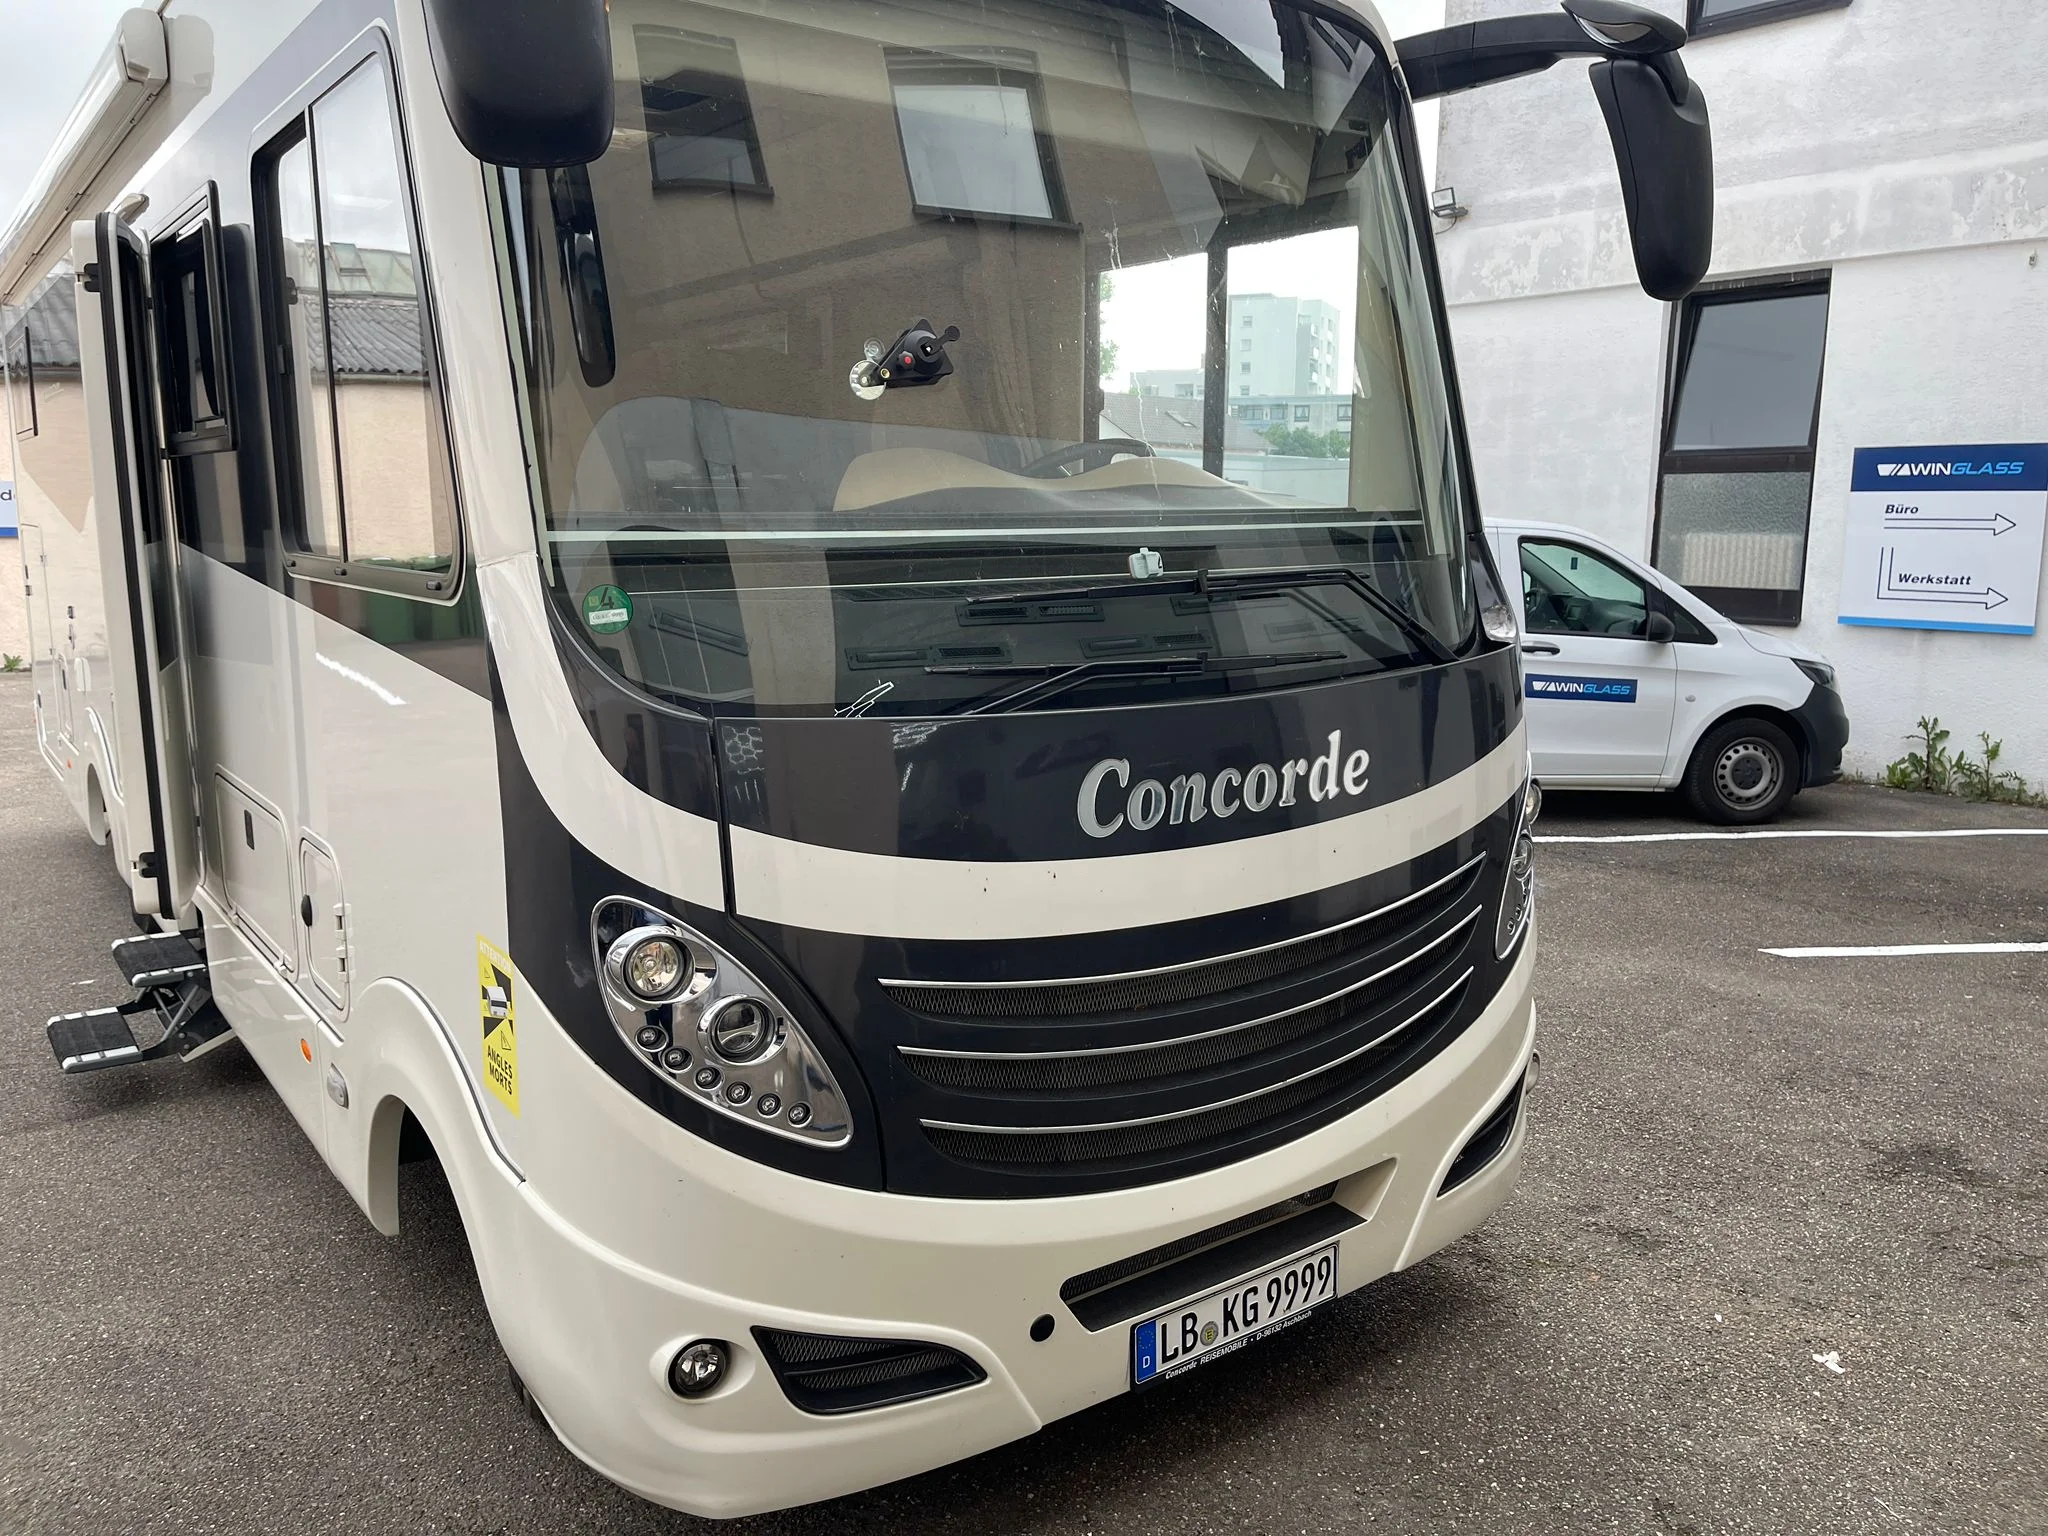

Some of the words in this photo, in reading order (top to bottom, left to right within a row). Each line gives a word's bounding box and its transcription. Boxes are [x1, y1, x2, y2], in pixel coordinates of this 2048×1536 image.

[1911, 461, 2025, 476] WINGLASS
[1884, 503, 1919, 515] Büro
[1898, 573, 1972, 586] Werkstatt
[1555, 681, 1632, 695] WINGLASS
[1077, 729, 1371, 838] Concorde
[487, 1044, 513, 1079] ANGLES
[489, 1061, 513, 1096] MORTS
[1161, 1311, 1198, 1364] LB
[1222, 1285, 1259, 1338] KG
[1266, 1255, 1332, 1319] 9999
[1165, 1360, 1198, 1380] Concorde
[1200, 1338, 1248, 1366] REISEMOBILE
[1256, 1324, 1283, 1342] D-96132
[1282, 1310, 1313, 1329] Aschbach
[1142, 1355, 1151, 1370] D
